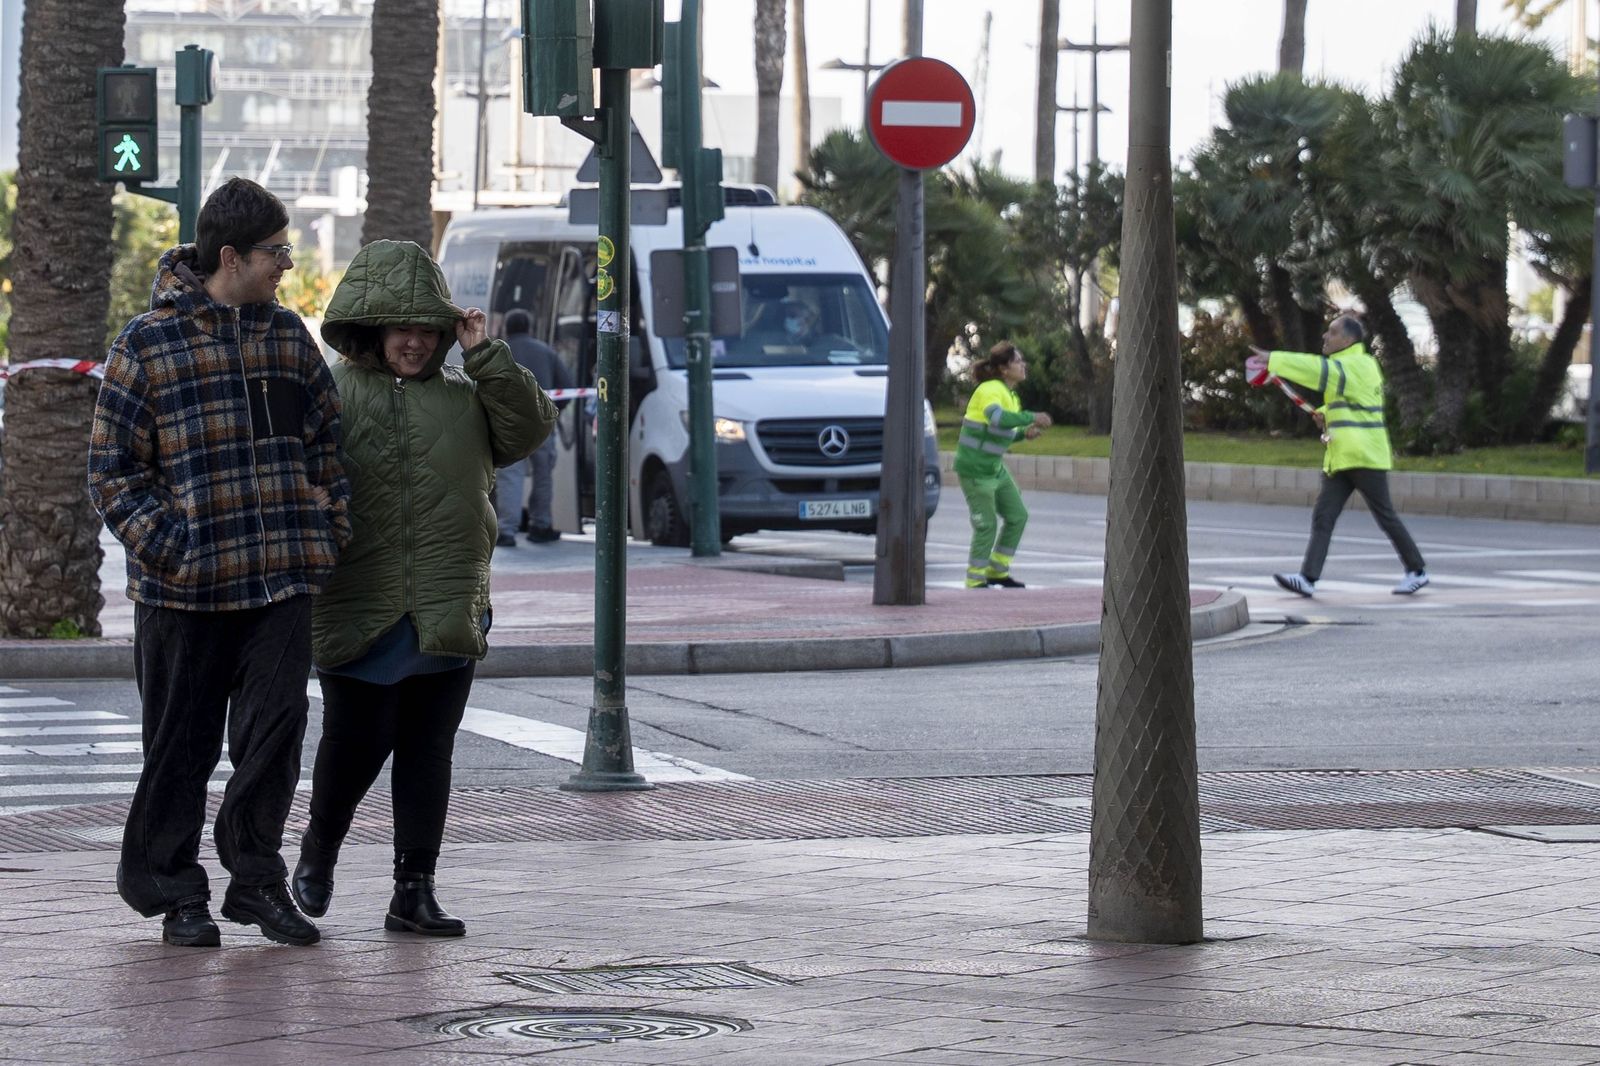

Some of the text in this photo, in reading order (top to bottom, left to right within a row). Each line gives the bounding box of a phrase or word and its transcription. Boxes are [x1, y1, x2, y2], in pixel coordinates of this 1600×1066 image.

[763, 256, 817, 267] hospital
[808, 502, 866, 516] 5274 LNB
